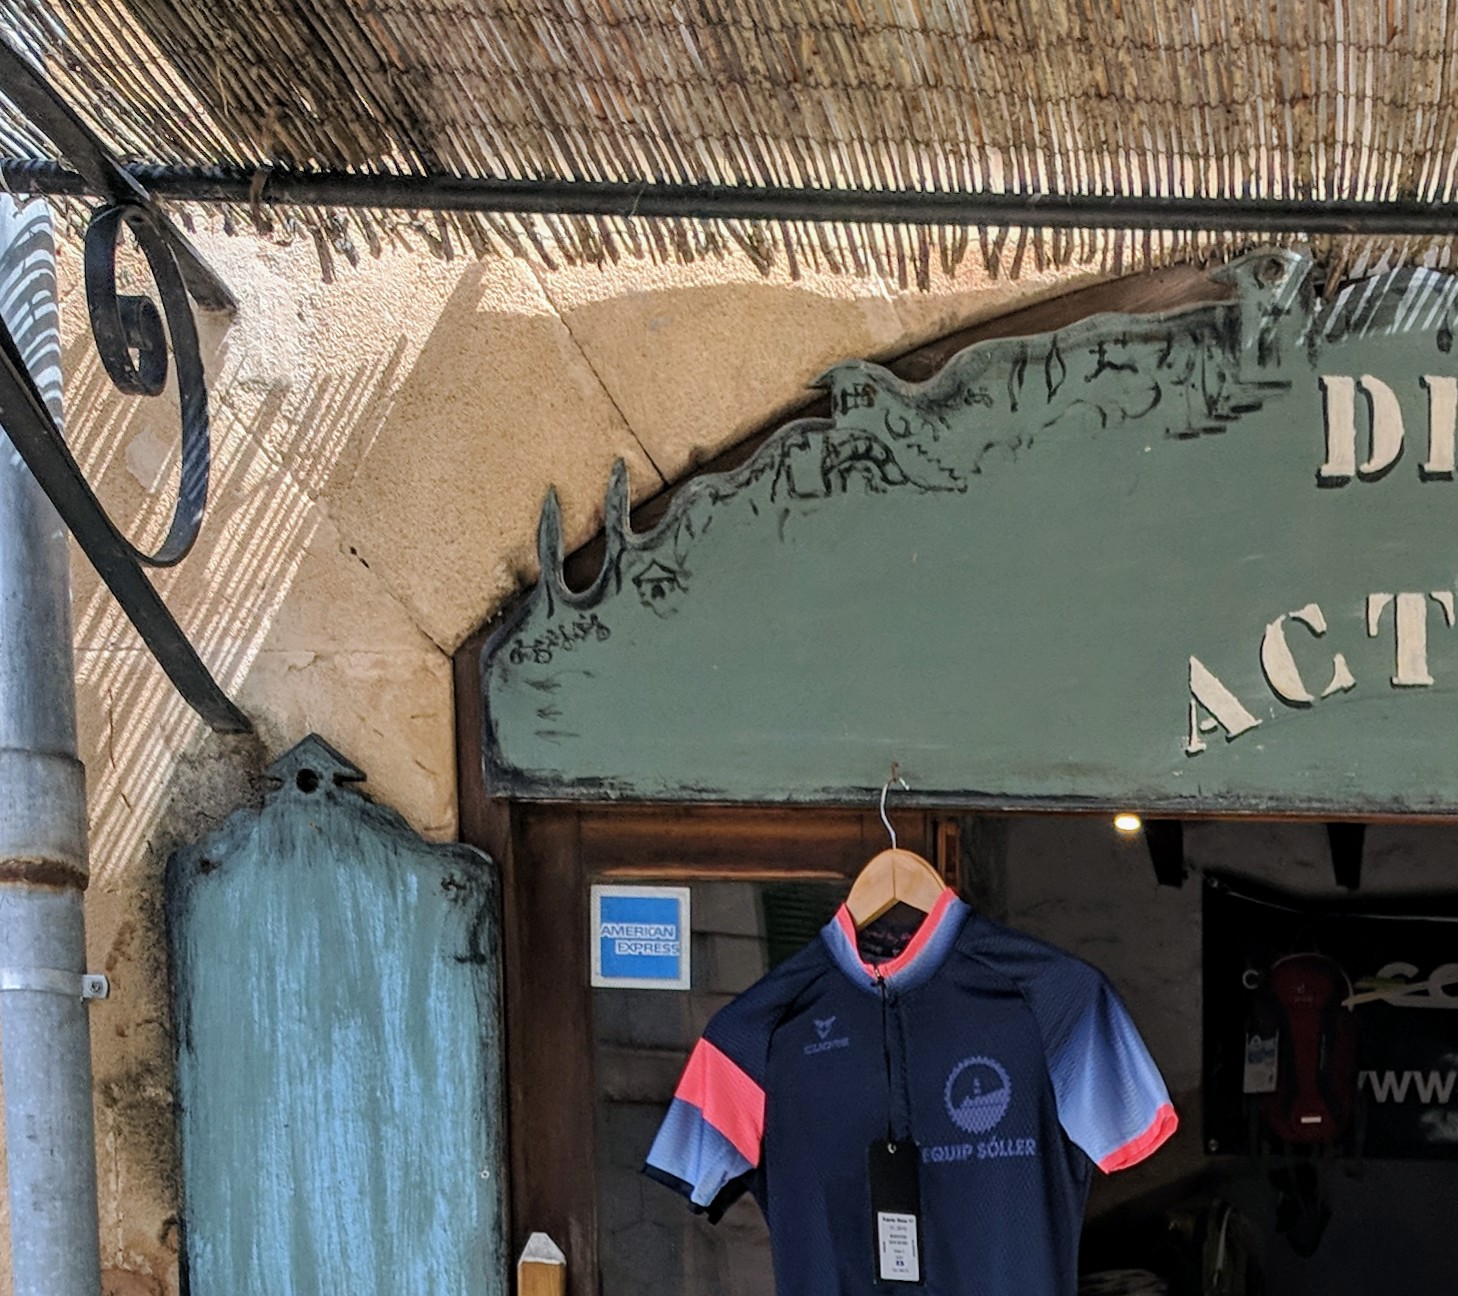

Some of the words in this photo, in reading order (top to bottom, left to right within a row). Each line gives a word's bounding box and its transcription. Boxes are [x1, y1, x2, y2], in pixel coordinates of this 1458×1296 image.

[600, 924, 676, 939] AMERICAN
[616, 941, 680, 956] EXPRESS
[976, 1136, 1037, 1159] SÓLLER
